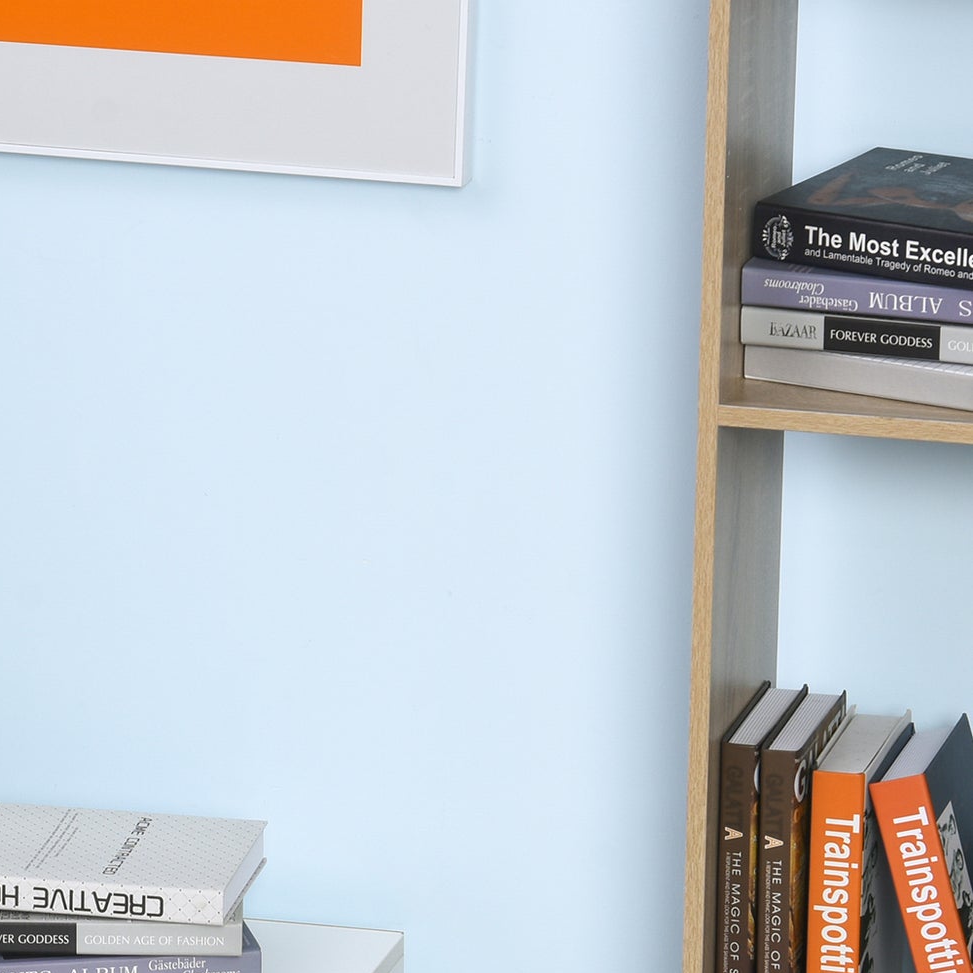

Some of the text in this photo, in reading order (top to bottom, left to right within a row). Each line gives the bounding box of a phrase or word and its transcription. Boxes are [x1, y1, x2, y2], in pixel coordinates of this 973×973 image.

[805, 225, 842, 249] The
[849, 231, 899, 258] Most
[804, 248, 821, 258] and
[823, 249, 873, 266] Lamentable
[876, 257, 911, 273] Tragedy
[913, 263, 923, 272] of
[924, 264, 956, 278] Romeo
[765, 278, 825, 295] Cloakrooms
[869, 291, 943, 314] ALBUM
[830, 329, 877, 344] FOREVER
[880, 333, 933, 349] GODDESS
[947, 340, 973, 353] GOL
[732, 851, 742, 876] THE
[772, 860, 782, 884] THE
[33, 886, 164, 917] CREATIVE
[730, 883, 741, 934] MAGIC
[771, 892, 781, 943] MAGIC
[19, 934, 70, 945] GODDESS
[84, 934, 130, 946] GOLDEN
[134, 935, 155, 946] AGE
[159, 935, 174, 946] OF
[177, 935, 225, 947] FASHION
[730, 941, 740, 961] OF
[148, 958, 206, 972] Gästebäder
[770, 950, 781, 970] OF
